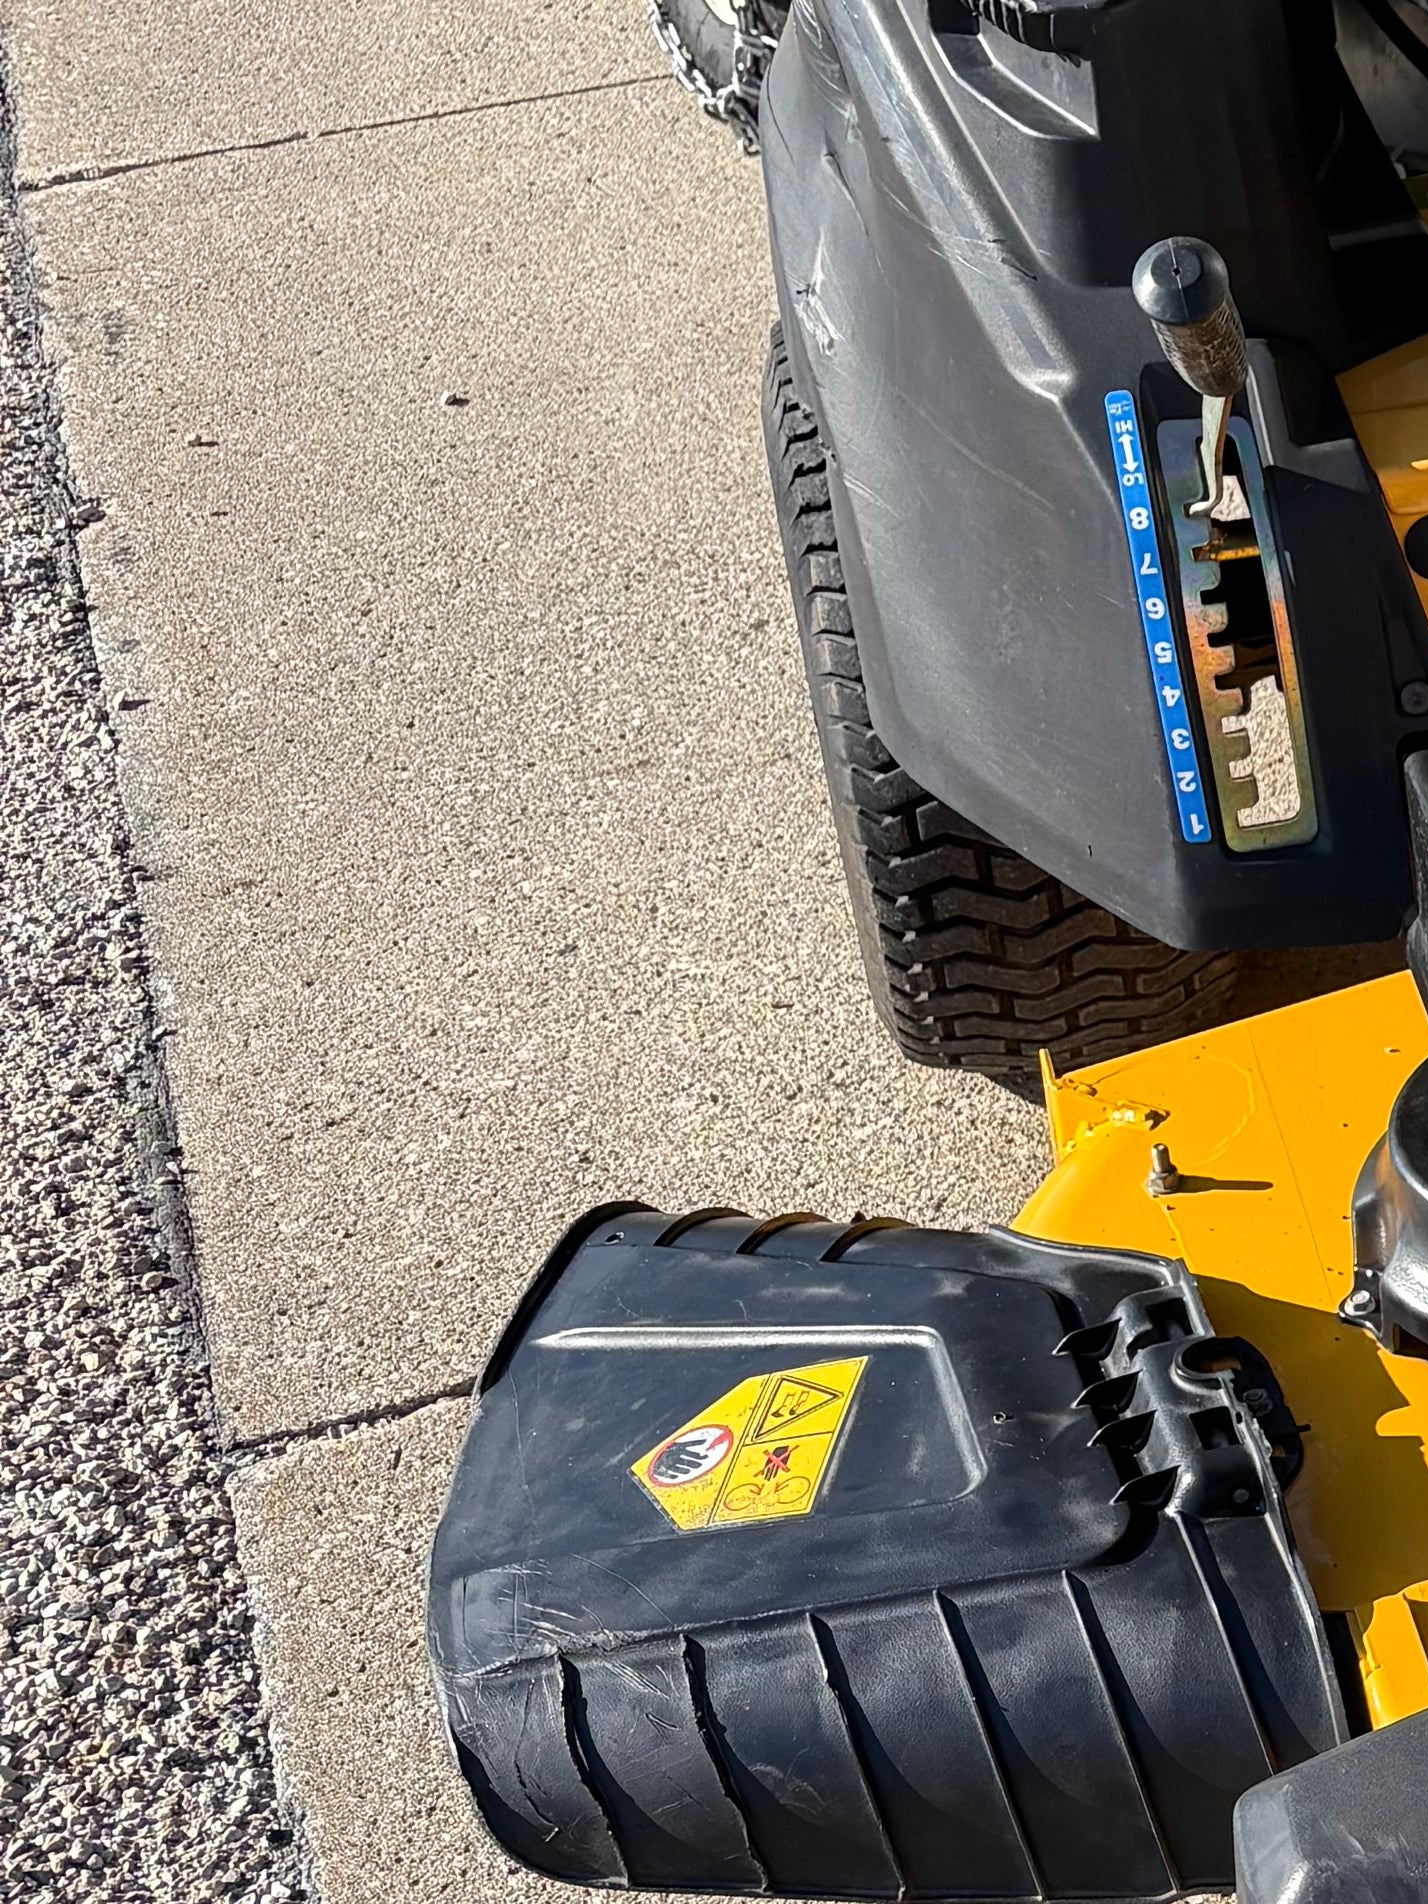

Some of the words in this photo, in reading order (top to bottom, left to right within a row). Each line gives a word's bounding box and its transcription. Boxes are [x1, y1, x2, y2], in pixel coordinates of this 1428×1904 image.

[1129, 506, 1150, 531] 8
[1140, 552, 1159, 576] 7
[1145, 597, 1166, 621] 6
[1153, 641, 1173, 665] 5
[1161, 685, 1182, 708] 4
[1171, 727, 1191, 750] 3
[1177, 770, 1197, 793] 2
[1189, 813, 1205, 835] 1
